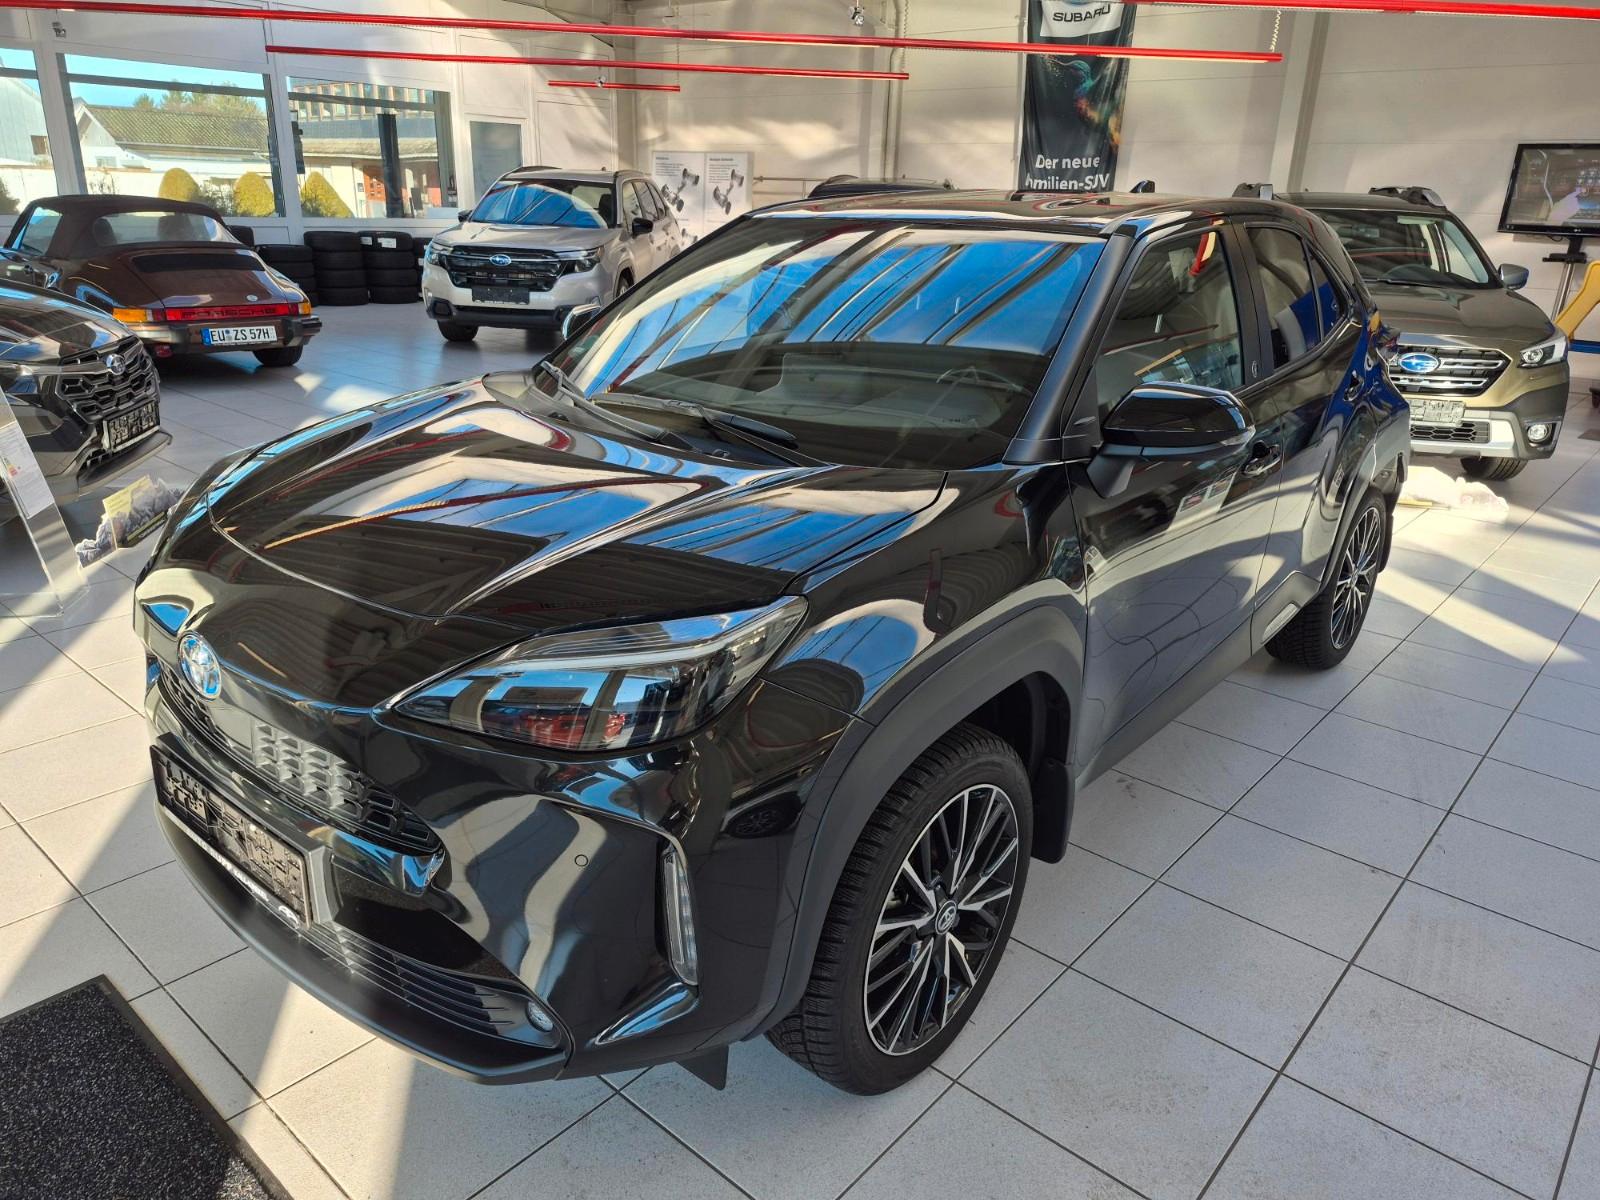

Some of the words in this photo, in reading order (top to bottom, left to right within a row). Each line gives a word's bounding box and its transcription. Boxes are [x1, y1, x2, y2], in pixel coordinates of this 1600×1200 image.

[1052, 3, 1110, 22] SUBARU
[1035, 154, 1059, 169] Der
[1062, 156, 1100, 169] neue
[211, 330, 226, 342] EU
[233, 329, 247, 341] ZS
[249, 328, 270, 340] 57H
